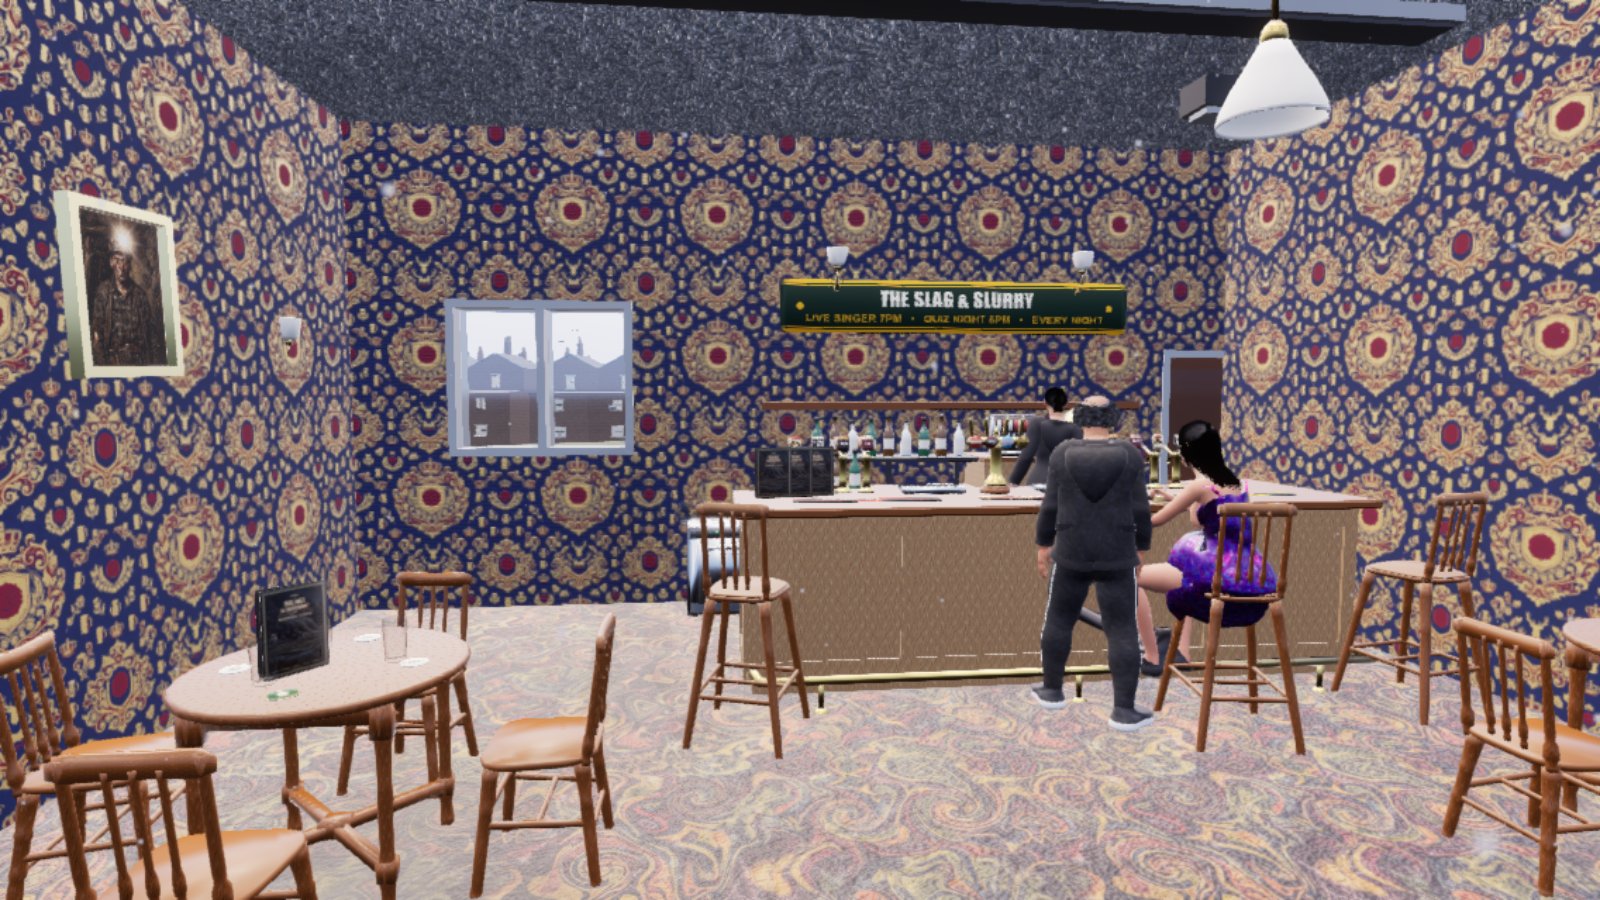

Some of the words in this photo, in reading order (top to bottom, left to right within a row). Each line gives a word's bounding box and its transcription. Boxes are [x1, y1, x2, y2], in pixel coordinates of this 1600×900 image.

[880, 290, 910, 308] THE
[914, 290, 954, 308] SLAG
[957, 294, 969, 309] &
[973, 291, 1035, 310] SLURRY
[805, 313, 830, 322] LIVE
[833, 313, 877, 323] SINGER
[880, 313, 903, 323] 7PM
[923, 314, 950, 323] QUIZ
[953, 314, 986, 324] NIGHT
[1031, 315, 1068, 325] EVERY
[1071, 315, 1103, 325] NIGHT
